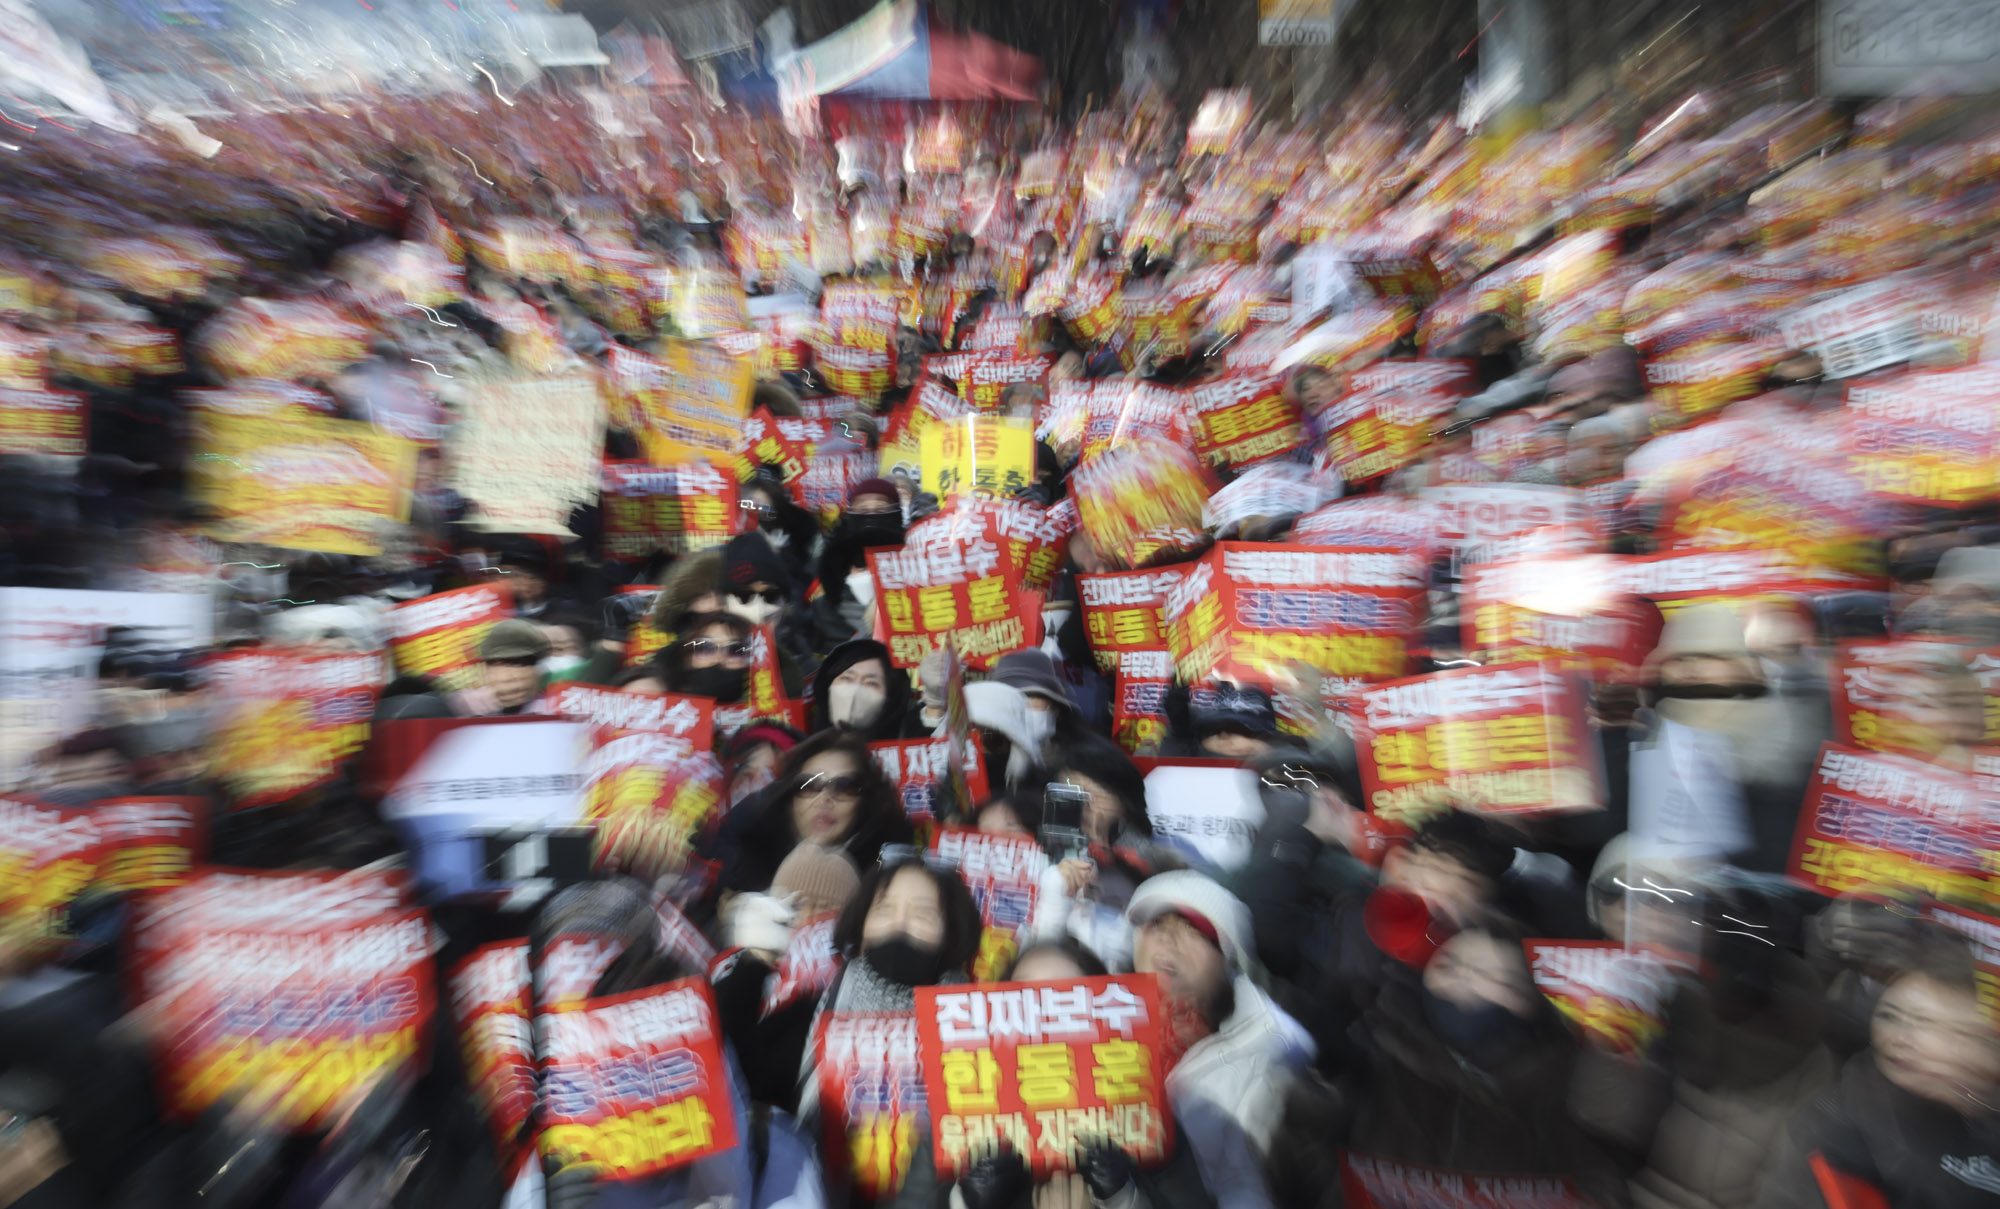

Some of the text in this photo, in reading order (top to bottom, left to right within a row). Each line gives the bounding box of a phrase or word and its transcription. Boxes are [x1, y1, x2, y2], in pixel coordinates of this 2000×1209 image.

[1267, 26, 1327, 45] 200m
[1081, 571, 1182, 606] 진짜보수
[935, 982, 1146, 1042] 진짜보수
